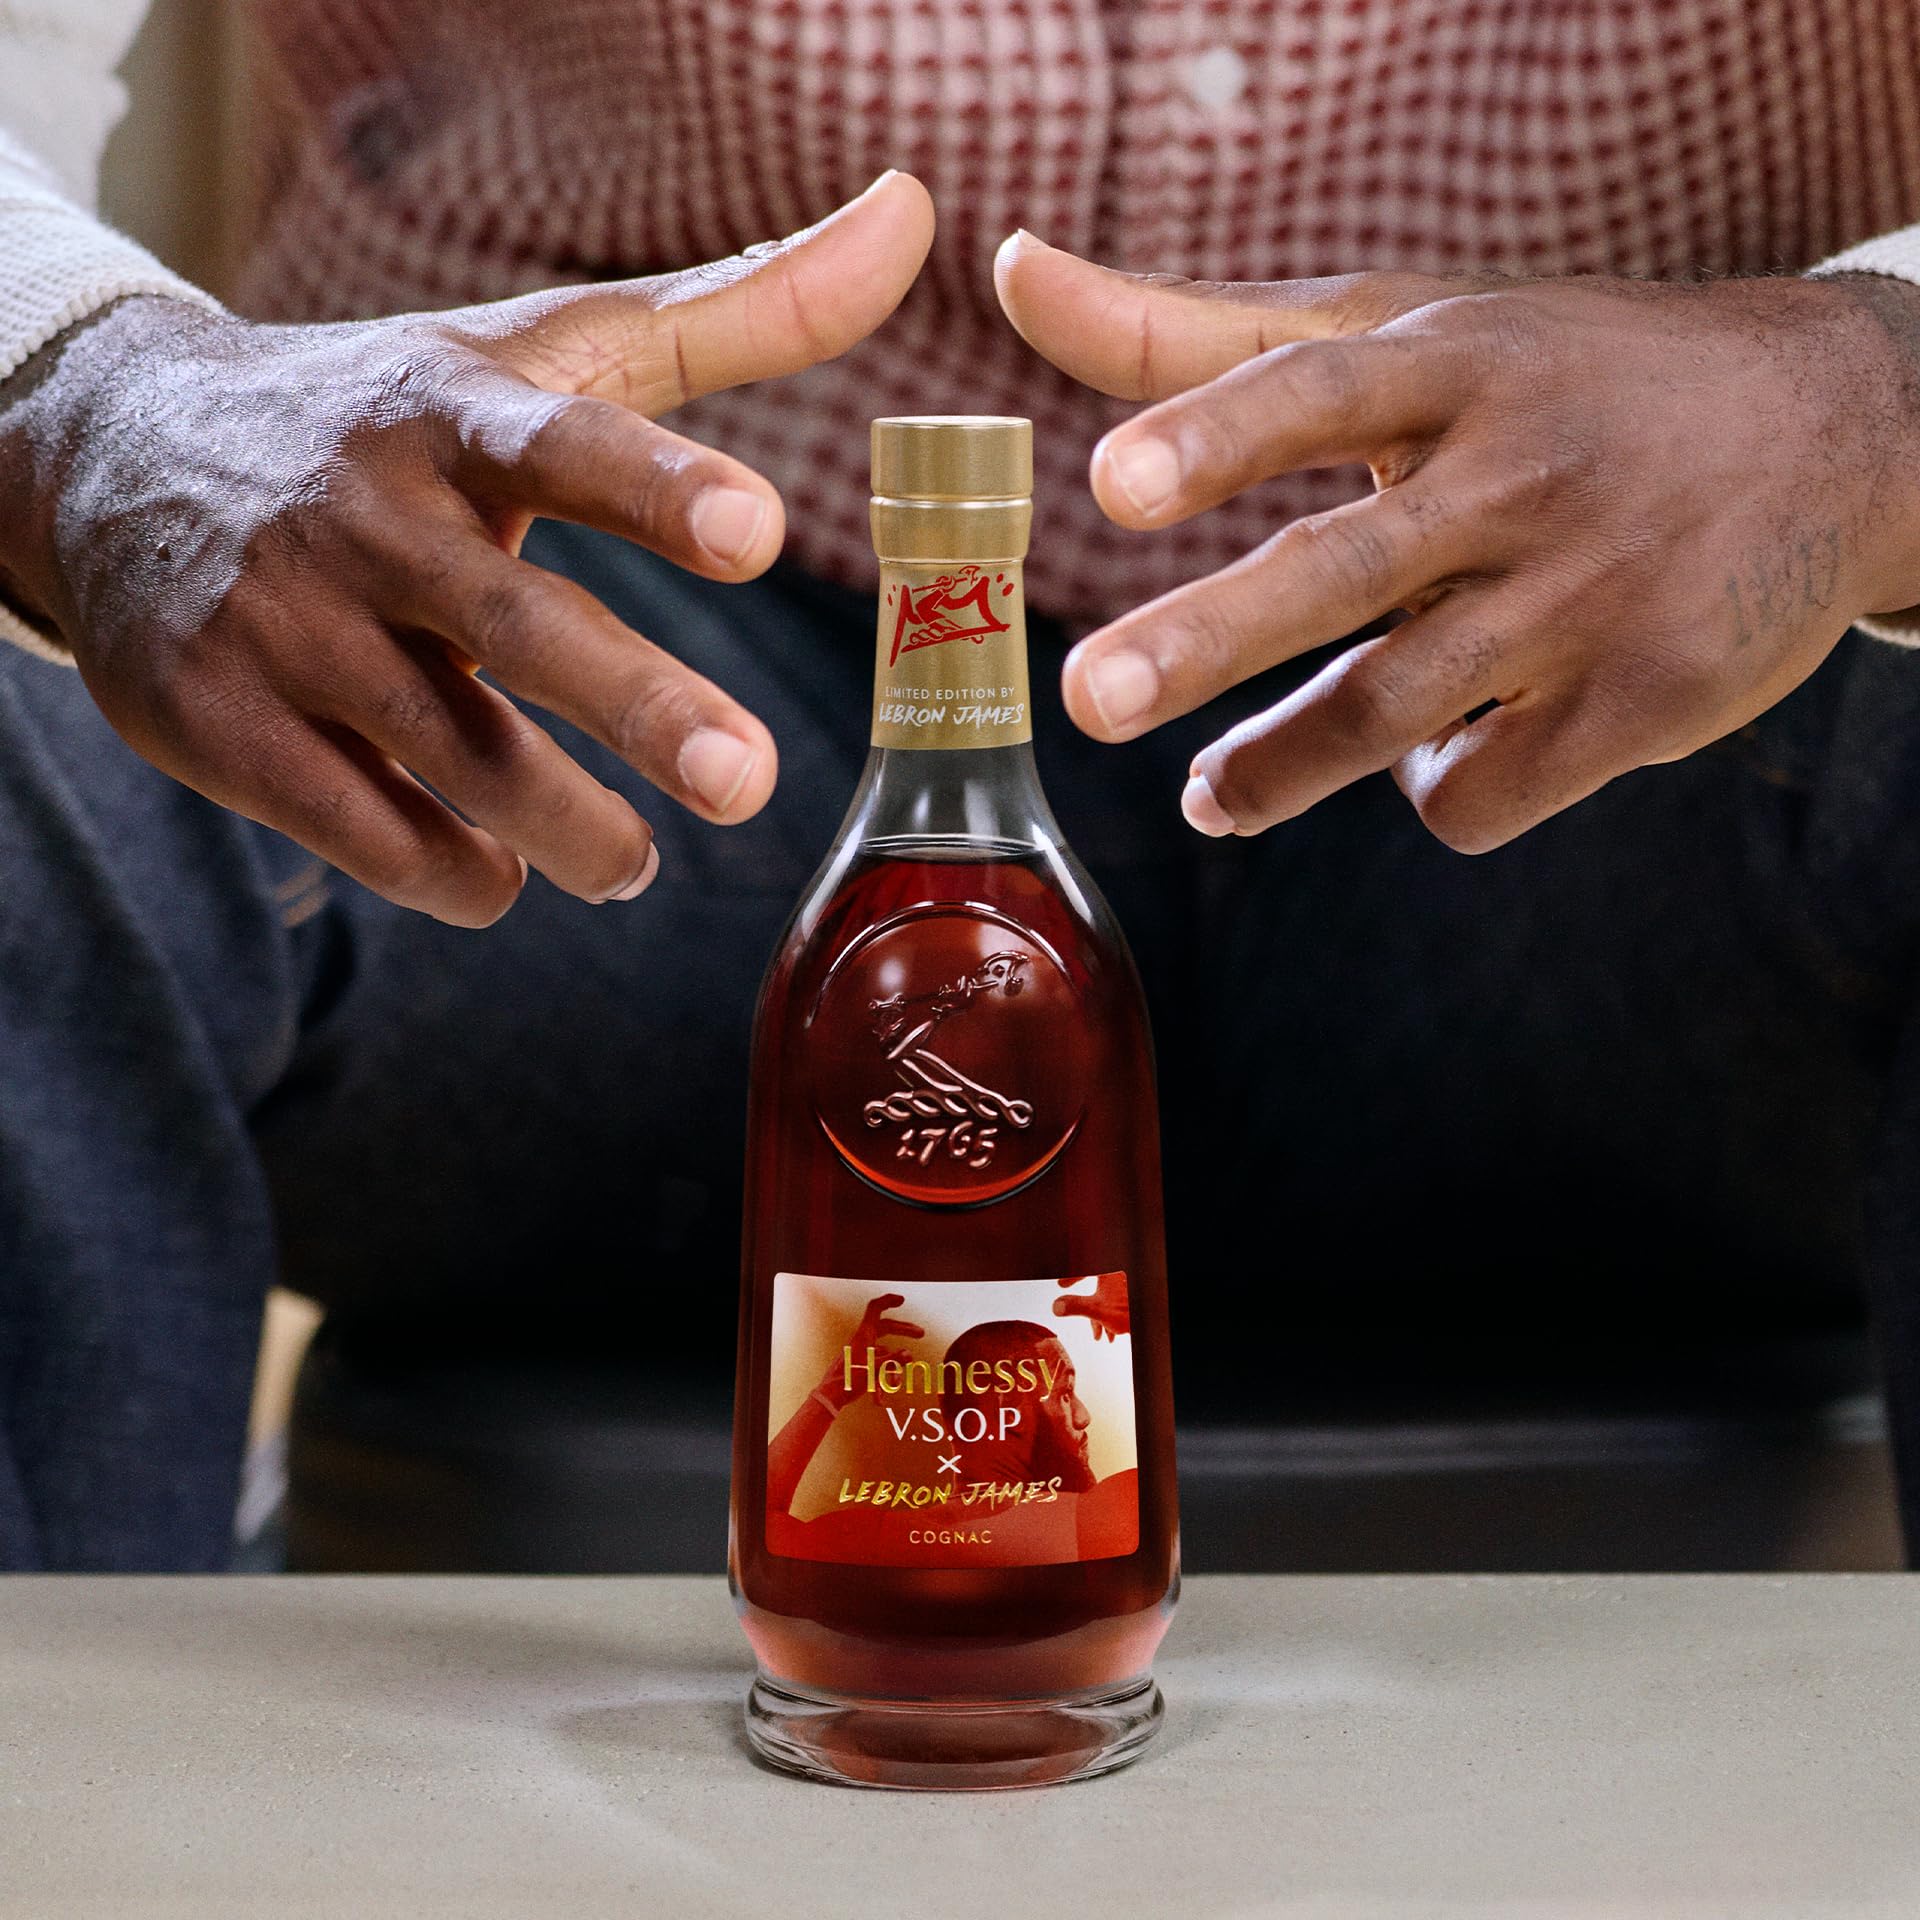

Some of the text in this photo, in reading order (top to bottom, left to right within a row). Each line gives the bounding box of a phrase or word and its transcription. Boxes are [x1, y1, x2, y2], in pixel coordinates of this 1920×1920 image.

[885, 686, 1015, 700] LIMITED EDITION BY
[878, 702, 1025, 730] LEBRON JAMES
[897, 1120, 998, 1168] 1765
[843, 1345, 1065, 1402] Hennessy
[886, 1407, 1022, 1443] V.S.O.P
[838, 1476, 1062, 1510] LEBRON JAMES
[909, 1530, 993, 1545] COGNAC
